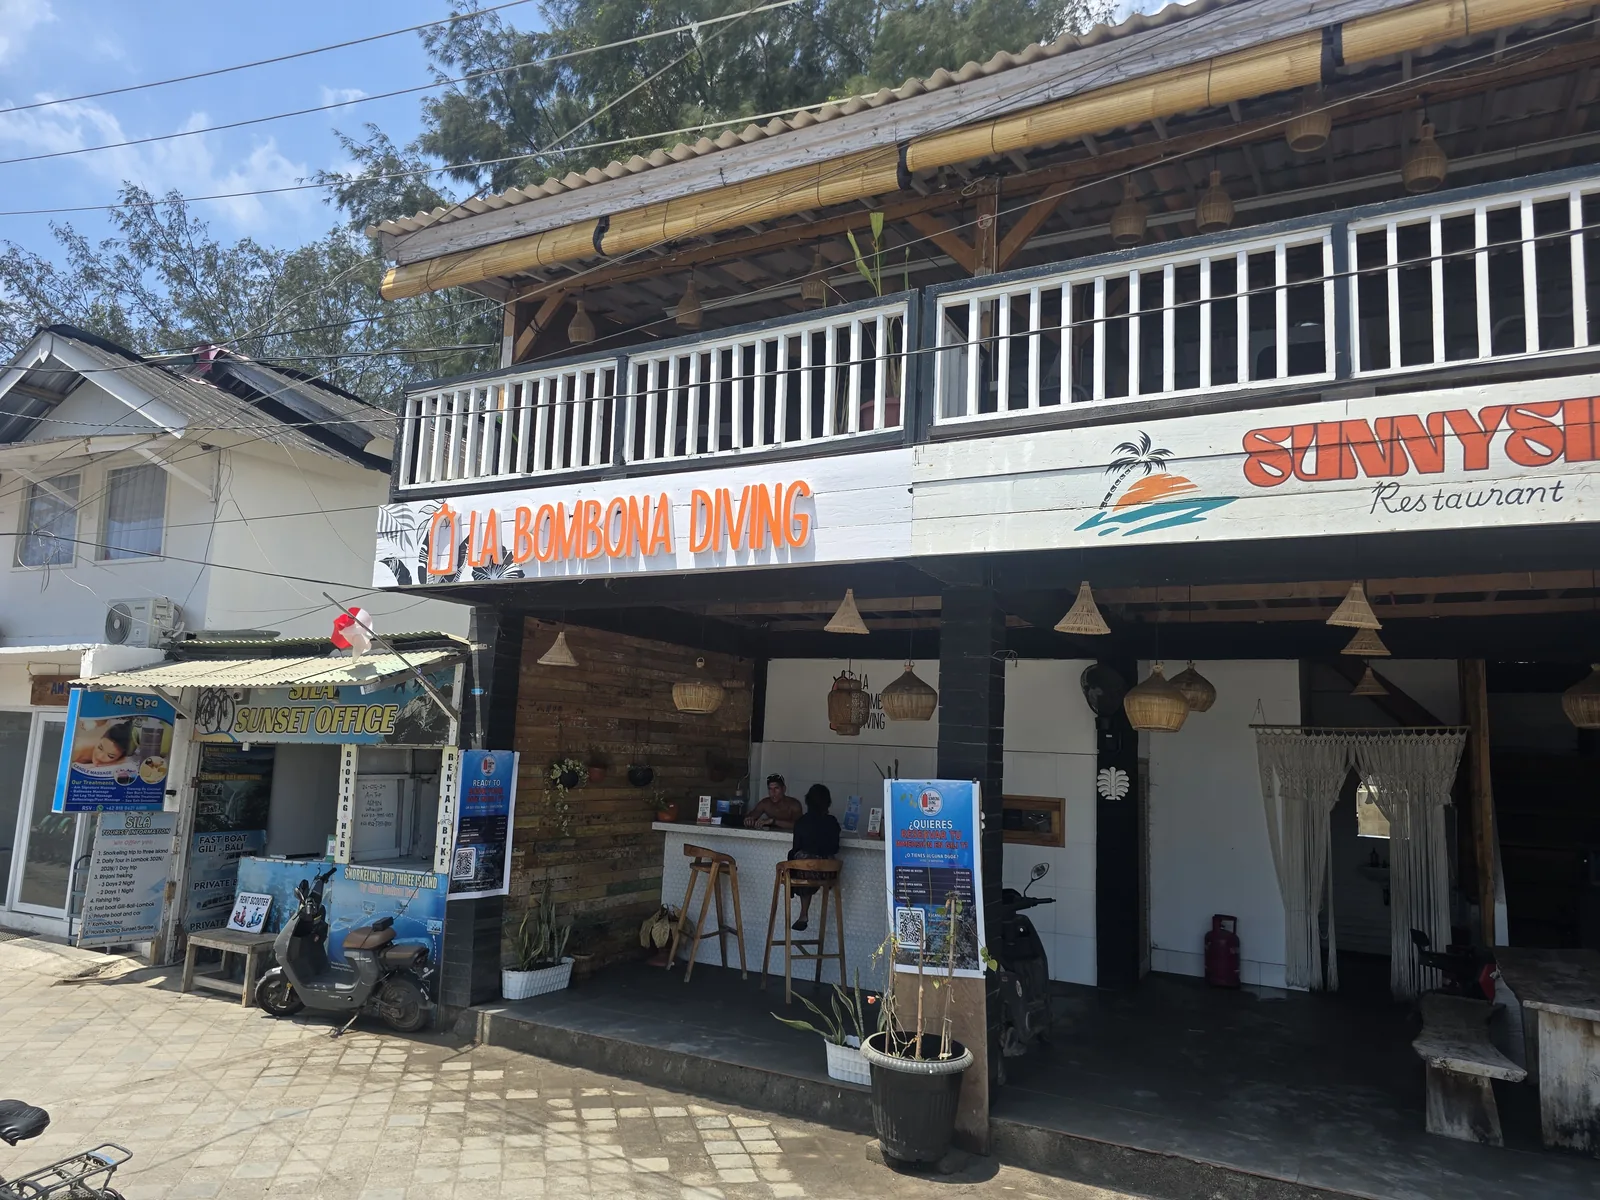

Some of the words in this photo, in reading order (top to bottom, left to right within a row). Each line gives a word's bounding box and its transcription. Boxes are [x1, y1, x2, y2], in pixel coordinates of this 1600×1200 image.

[1369, 479, 1566, 515] Restaurant
[467, 507, 500, 568] LA
[513, 491, 674, 564] BOMBONA
[689, 479, 813, 554] DIVING
[288, 685, 335, 701] SILA
[114, 695, 132, 706] AM
[135, 696, 159, 709] Spa
[233, 706, 316, 734] SUNSET
[315, 703, 401, 734] OFFICE
[342, 750, 352, 812] BOOKING
[444, 753, 454, 814] RENTAL
[472, 779, 492, 787] READY
[125, 815, 152, 829] SILA
[908, 819, 953, 831] ¿QUIERES
[101, 829, 129, 837] TOURIST
[128, 827, 172, 836] INFORMATION
[901, 829, 947, 840] RESERVAR
[950, 830, 962, 841] TU
[199, 835, 222, 844] FAST
[224, 834, 248, 843] BOAT
[934, 840, 943, 849] EN
[198, 845, 216, 854] GILI
[225, 843, 244, 852] BALI
[440, 826, 448, 866] BIKE
[344, 867, 381, 883] SNORKELING
[381, 870, 396, 885] TRIP
[396, 872, 415, 887] THREE
[415, 874, 438, 889] ISLAND
[193, 880, 231, 890] PRIVATE
[239, 895, 251, 904] RENT
[250, 896, 270, 907] SCOOTER
[189, 919, 227, 931] PRIVATE
